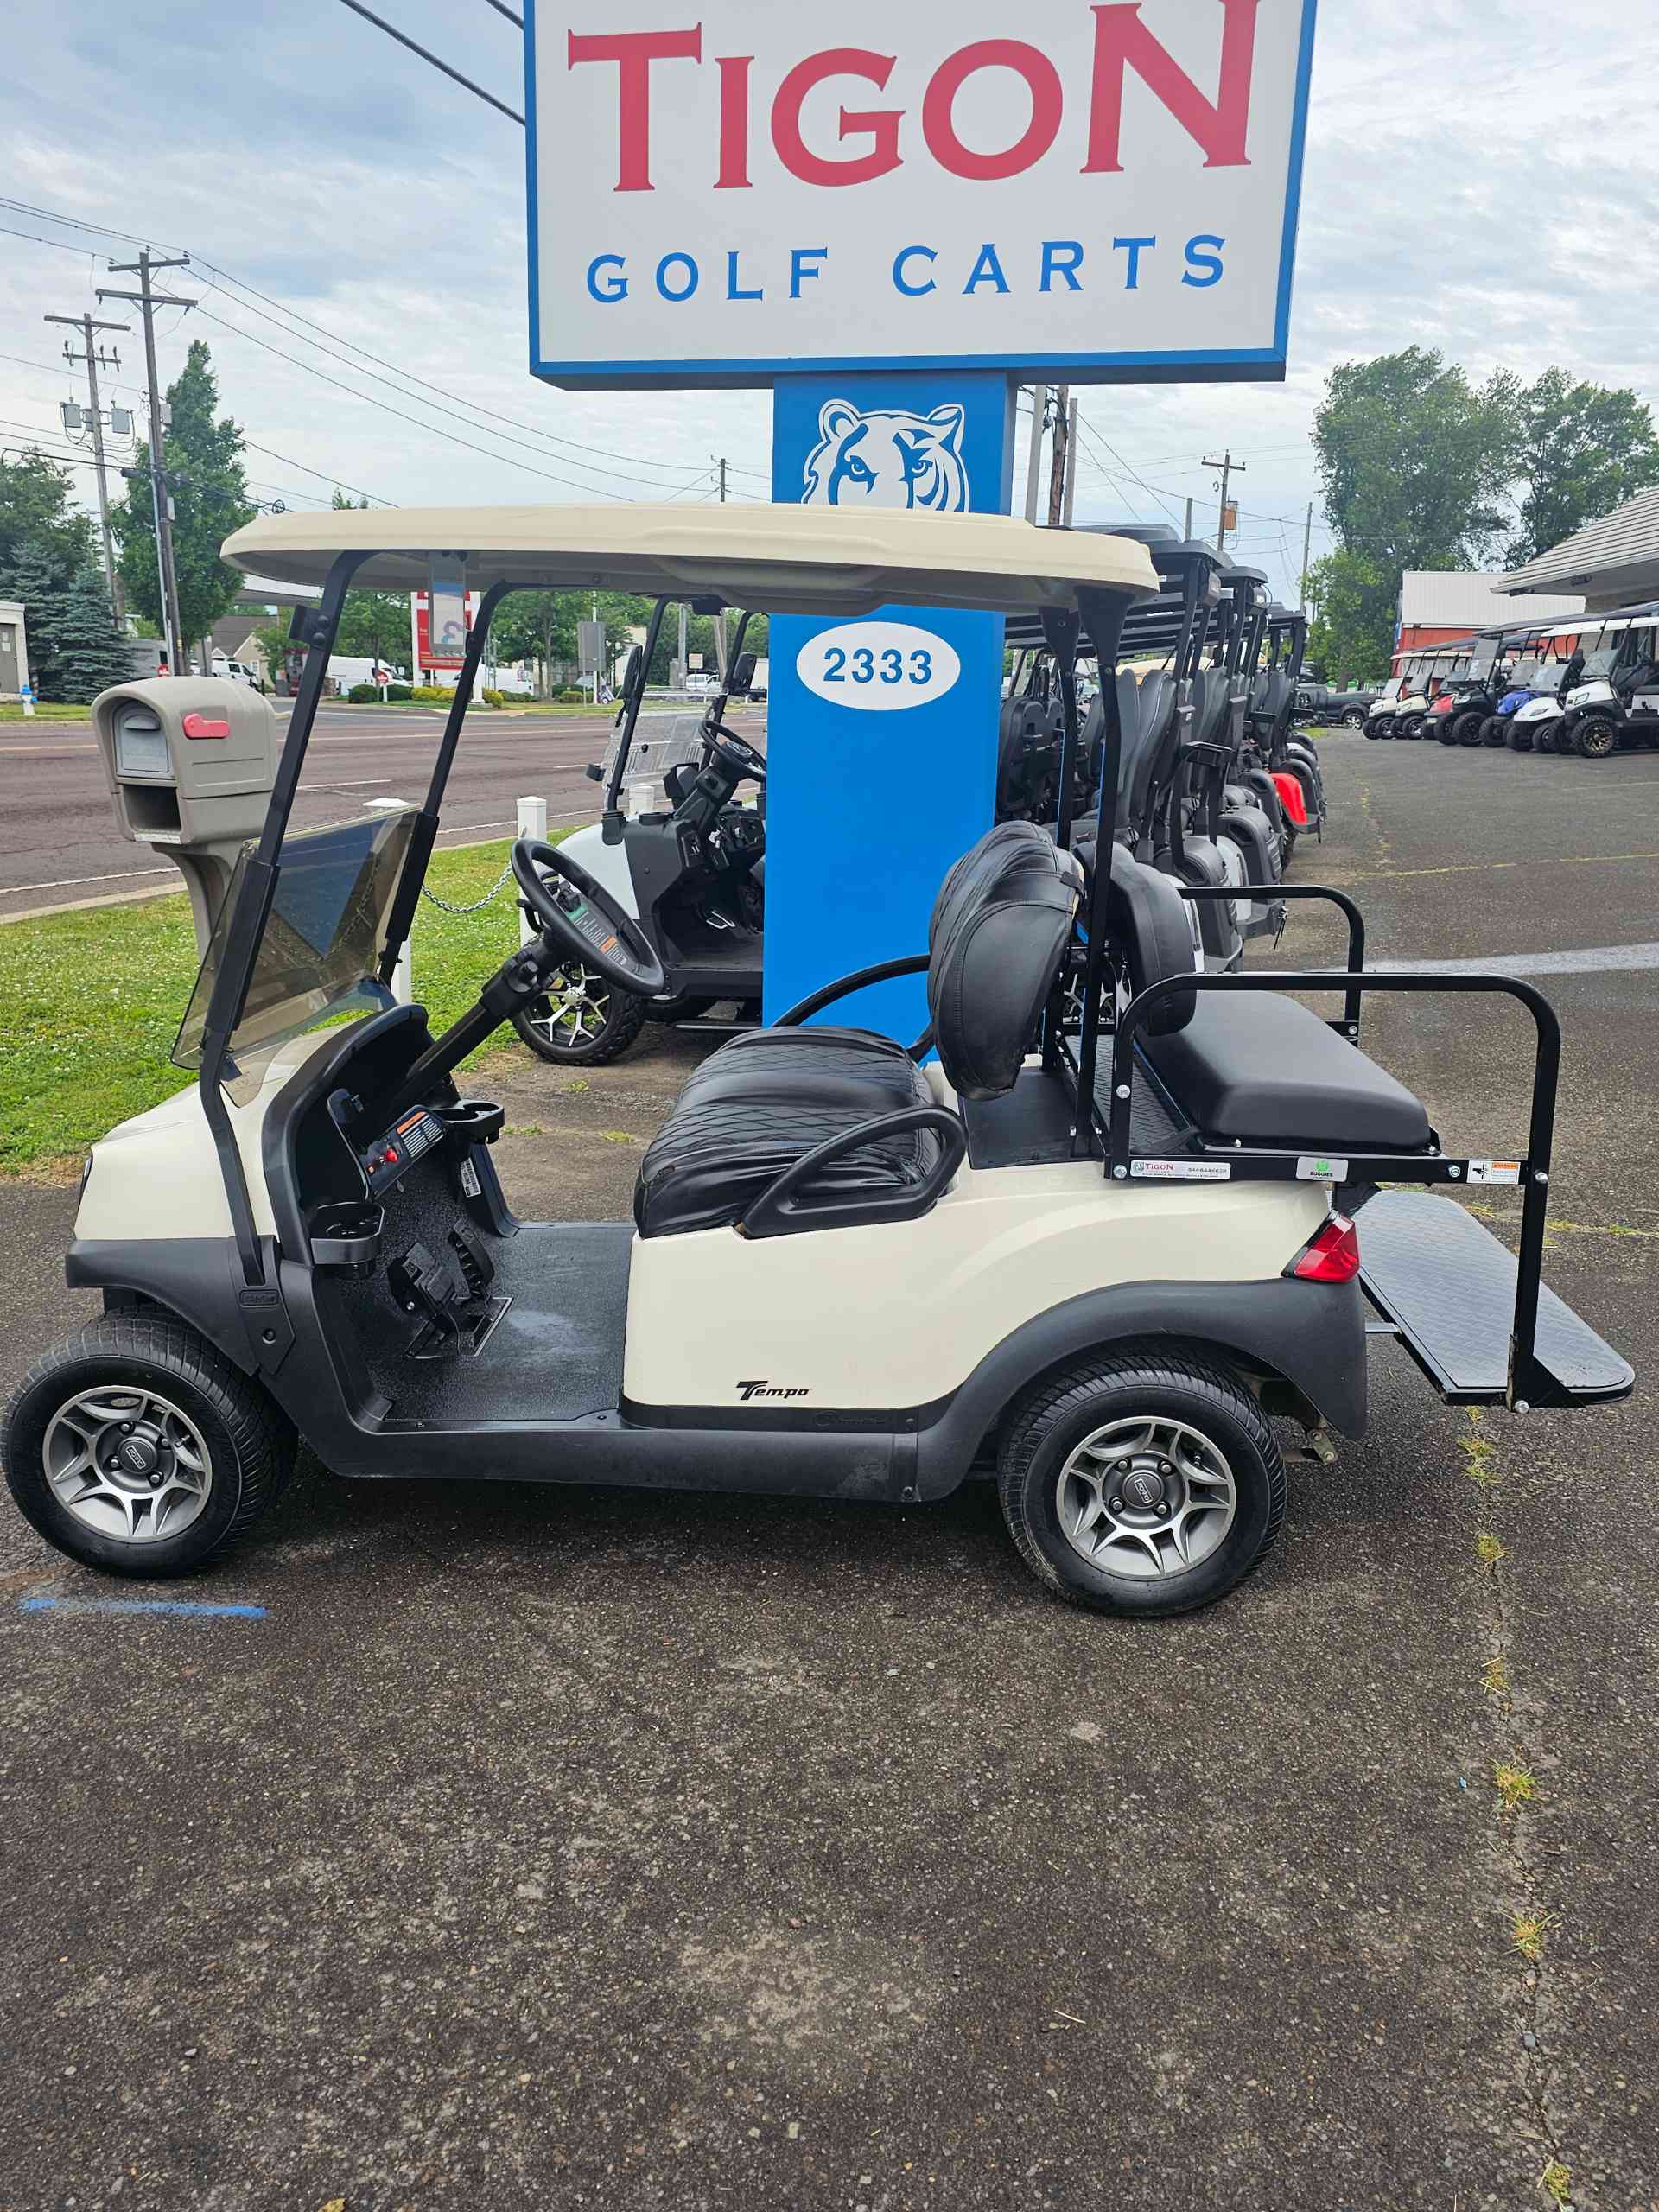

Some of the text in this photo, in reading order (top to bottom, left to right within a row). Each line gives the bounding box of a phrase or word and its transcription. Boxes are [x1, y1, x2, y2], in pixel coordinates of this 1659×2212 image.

[568, 0, 1258, 191] TIGON
[586, 234, 1226, 305] GOLF CARTS
[823, 647, 933, 685] 2333
[736, 1380, 810, 1401] Tempo
